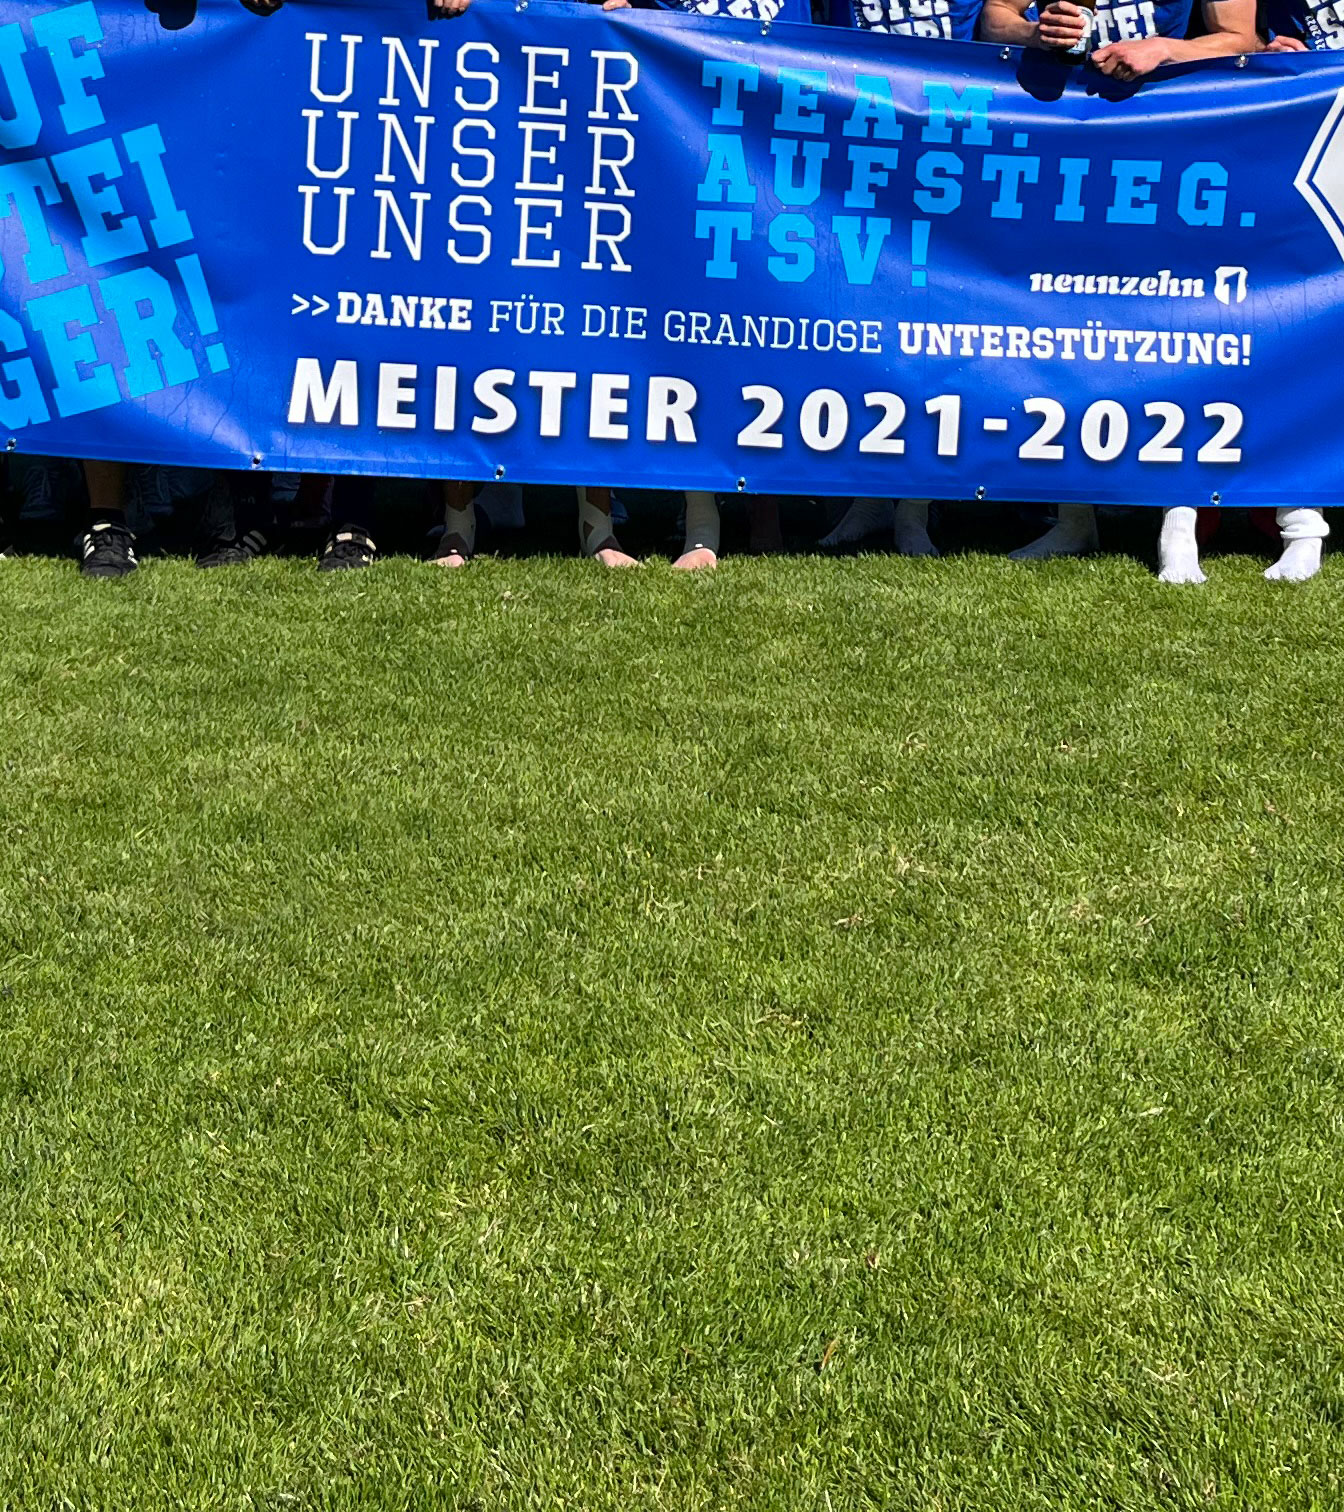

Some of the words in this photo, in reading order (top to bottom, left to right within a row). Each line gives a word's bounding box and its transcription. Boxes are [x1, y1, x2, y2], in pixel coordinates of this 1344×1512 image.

[1091, 0, 1157, 50] TEI
[305, 32, 639, 122] UNSER
[701, 59, 1029, 149] TEAM.
[301, 108, 636, 198] UNSER
[696, 133, 1256, 228] AUFSTIEG.
[297, 184, 632, 273] UNSER
[694, 209, 932, 288] TSV!
[1029, 269, 1206, 298] neunzehn
[488, 293, 565, 337] FÜR
[581, 304, 648, 341] DIE
[663, 309, 883, 355] GRANDIOSE
[898, 320, 1252, 367] UNTERSTÜTZUNG!
[286, 356, 698, 444] MEISTER
[736, 383, 1245, 465] 2021-2022
